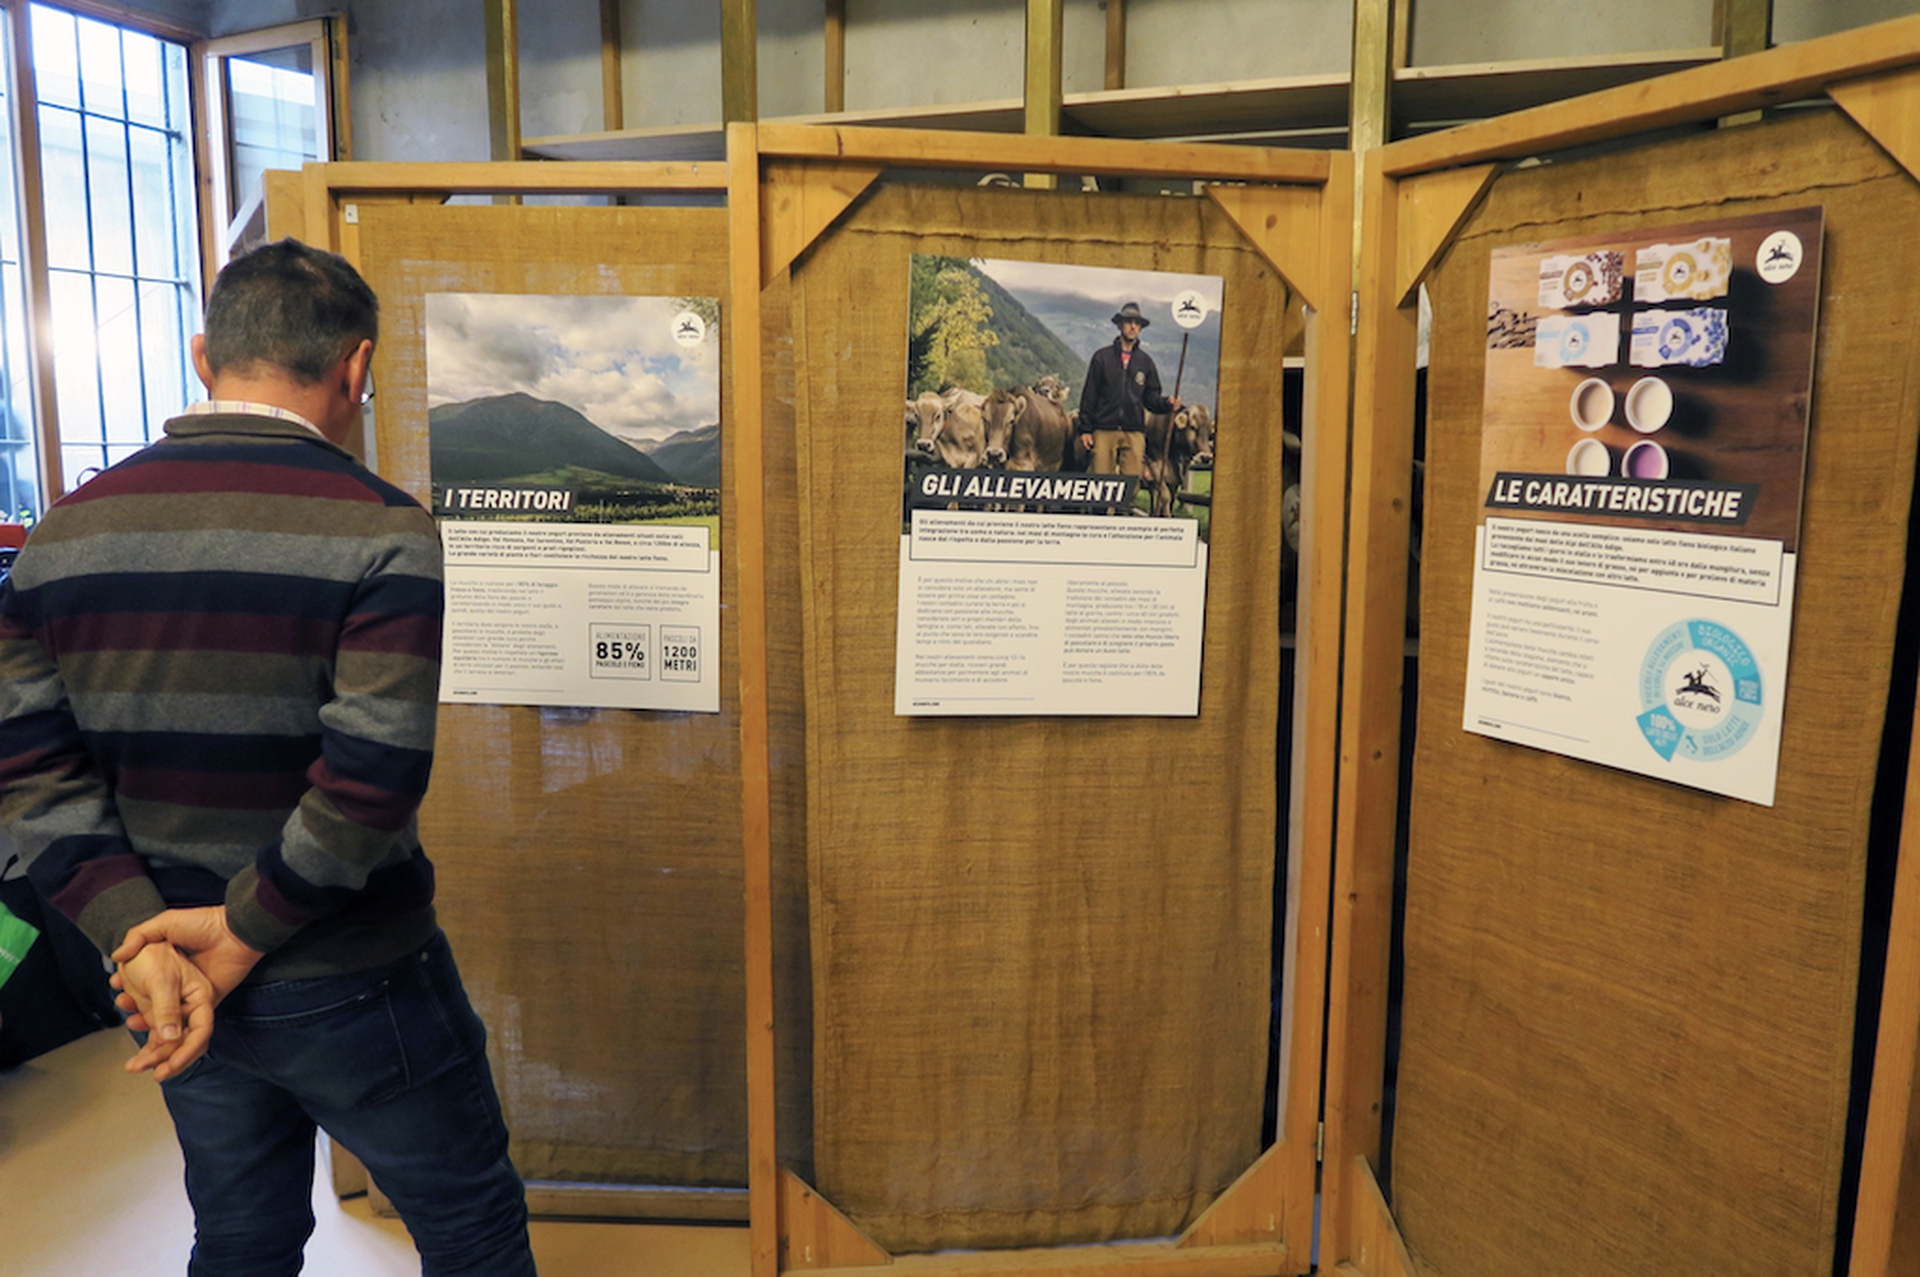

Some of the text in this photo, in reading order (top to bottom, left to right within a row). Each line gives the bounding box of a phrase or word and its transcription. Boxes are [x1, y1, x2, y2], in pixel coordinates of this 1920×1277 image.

[922, 474, 1126, 502] GLI ALLEVAMENTI
[1494, 479, 1742, 518] LE CARATTERISTICHE
[444, 488, 571, 510] I TERRITORI
[595, 641, 645, 661] 85%
[663, 645, 697, 659] 1200
[663, 658, 697, 672] METRI
